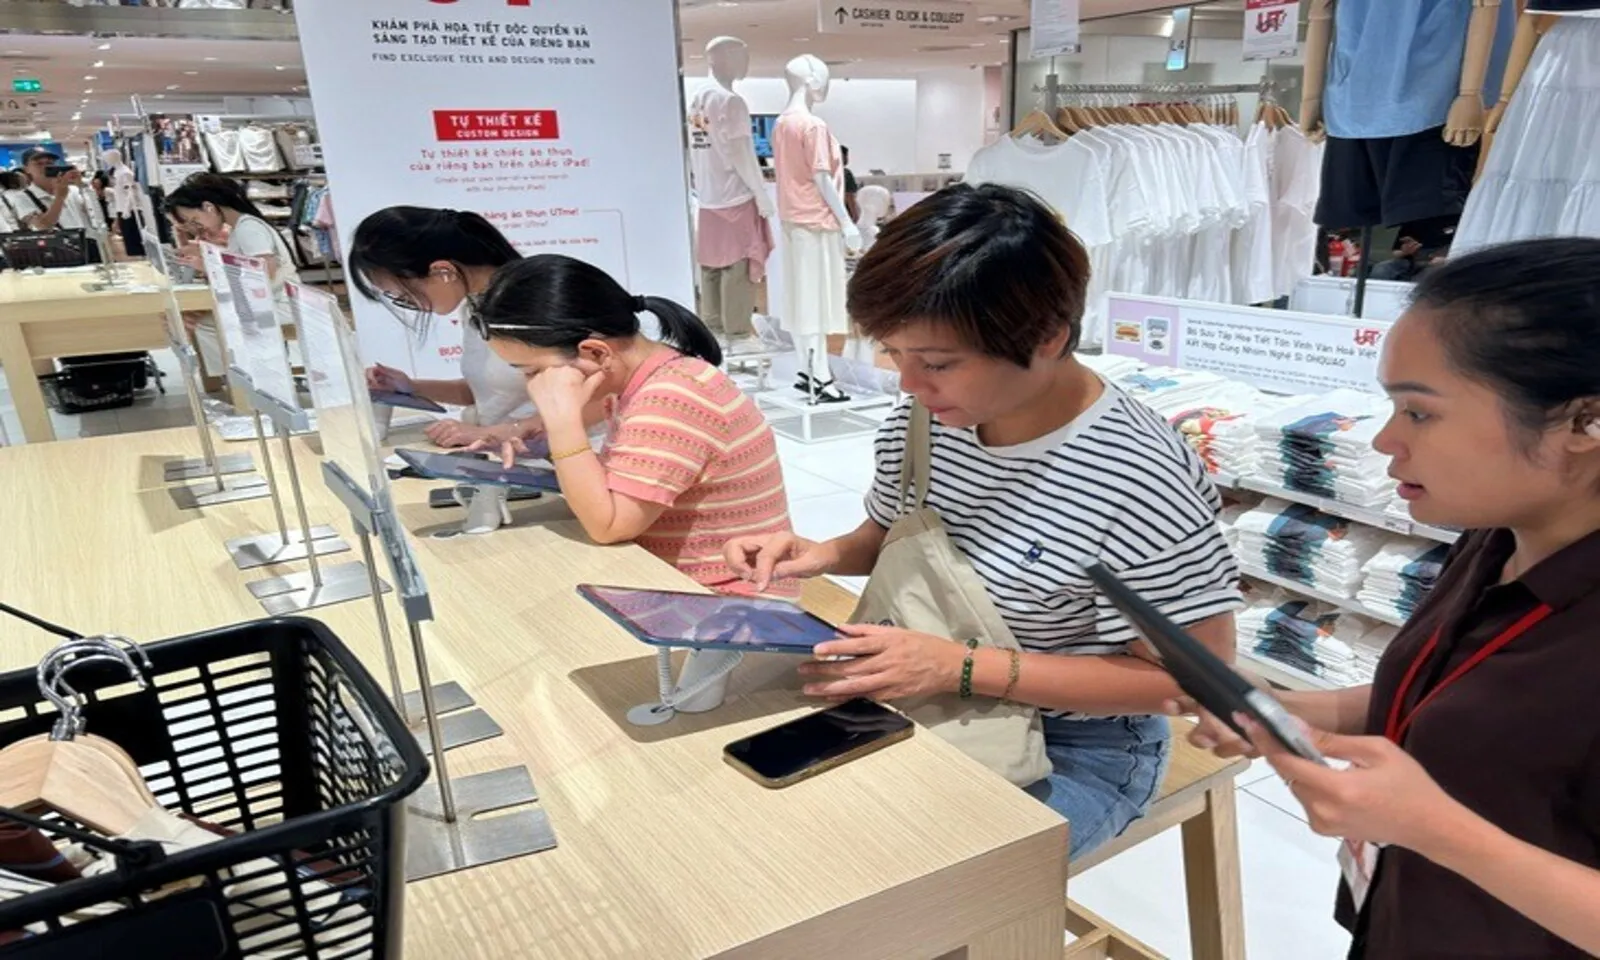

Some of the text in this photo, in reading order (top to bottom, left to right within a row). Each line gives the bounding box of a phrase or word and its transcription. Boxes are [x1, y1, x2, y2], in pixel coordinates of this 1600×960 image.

[852, 8, 965, 24] CASHIER CLICK & COLLECT
[372, 53, 596, 66] FIND EXCLUSIVE TEES AND DESIGN YOUR OWN
[456, 128, 540, 139] CUSTOM DESIGN
